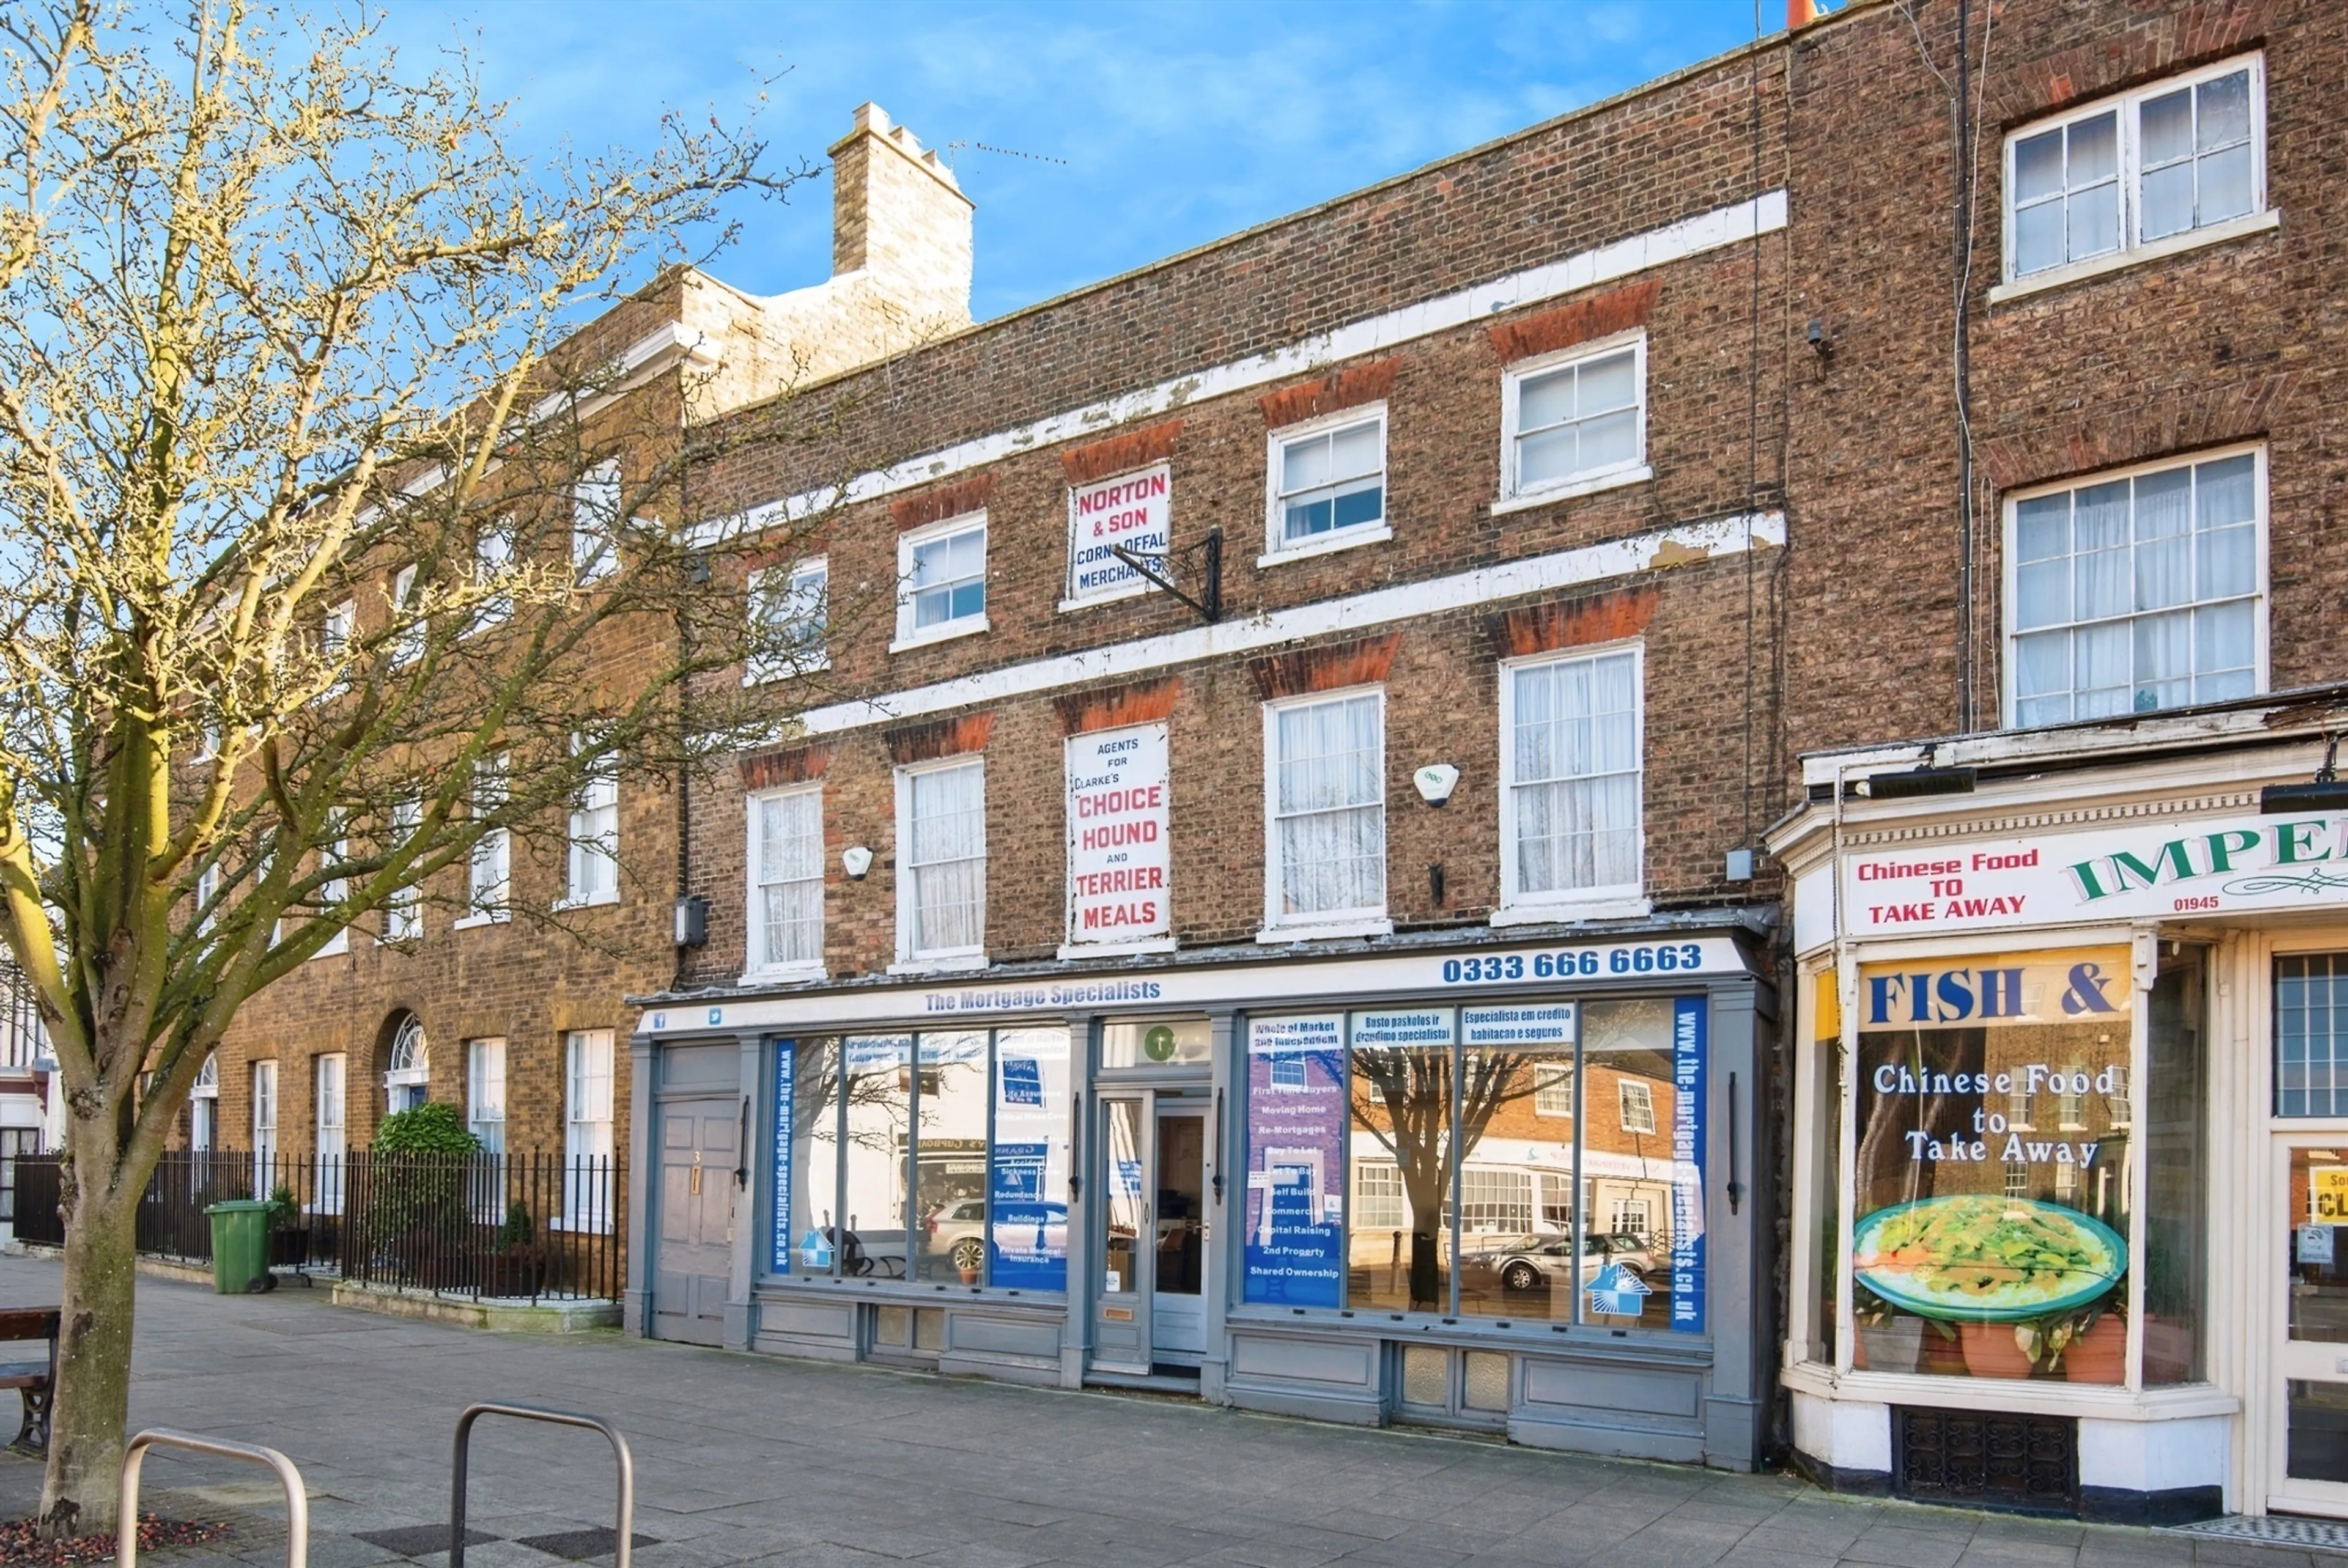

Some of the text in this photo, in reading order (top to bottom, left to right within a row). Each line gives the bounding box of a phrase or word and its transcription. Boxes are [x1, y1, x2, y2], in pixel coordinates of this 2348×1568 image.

[1079, 473, 1165, 516] NORTON
[1093, 507, 1147, 537] & SON
[1077, 532, 1166, 565] CORN OFFAL
[1097, 738, 1139, 755] AGENTS
[1107, 757, 1127, 768] FOR
[1083, 820, 1157, 851] HOUND
[1107, 853, 1128, 864] AND
[1858, 848, 2038, 881] Chinese Food
[2061, 817, 2348, 905] IMPE
[1077, 867, 1162, 897] TERRIER
[1930, 878, 1963, 897] TO
[1869, 895, 2026, 924] TAKE AWAY
[2174, 896, 2219, 911] 01945
[1084, 902, 1156, 929] MEALS
[1443, 944, 1701, 982] 0333 666 6663
[925, 981, 1161, 1010] The Mortgage Specialists
[1867, 963, 2120, 1024] FISH &
[1365, 1014, 1439, 1029] Busto paskolos ir
[1465, 1008, 1570, 1025] Especialista em credito
[1255, 1021, 1334, 1034] Whole of Market
[1398, 1028, 1450, 1042] specialistai
[1471, 1027, 1562, 1041] habitacao e seguros
[1874, 1064, 2116, 1094] Chinese Food
[1253, 1086, 1275, 1095] First
[1262, 1105, 1326, 1115] Moving Home
[1973, 1106, 2006, 1133] to
[1258, 1126, 1326, 1135] Re-Mortgages
[776, 1050, 792, 1265] www.the-mortgage-specialists.co.uk
[1906, 1131, 2097, 1168] Take Away
[1299, 1167, 1318, 1177] Buy
[1673, 1012, 1699, 1321] www.the-mortgage-specialists.co.uk
[2331, 1174, 2348, 1186] So
[1270, 1187, 1315, 1196] Self Build
[1008, 1214, 1044, 1223] Buildings
[1258, 1225, 1331, 1237] Capital Raising
[1282, 1247, 1325, 1257] Property
[1250, 1267, 1338, 1279] Shared Ownership
